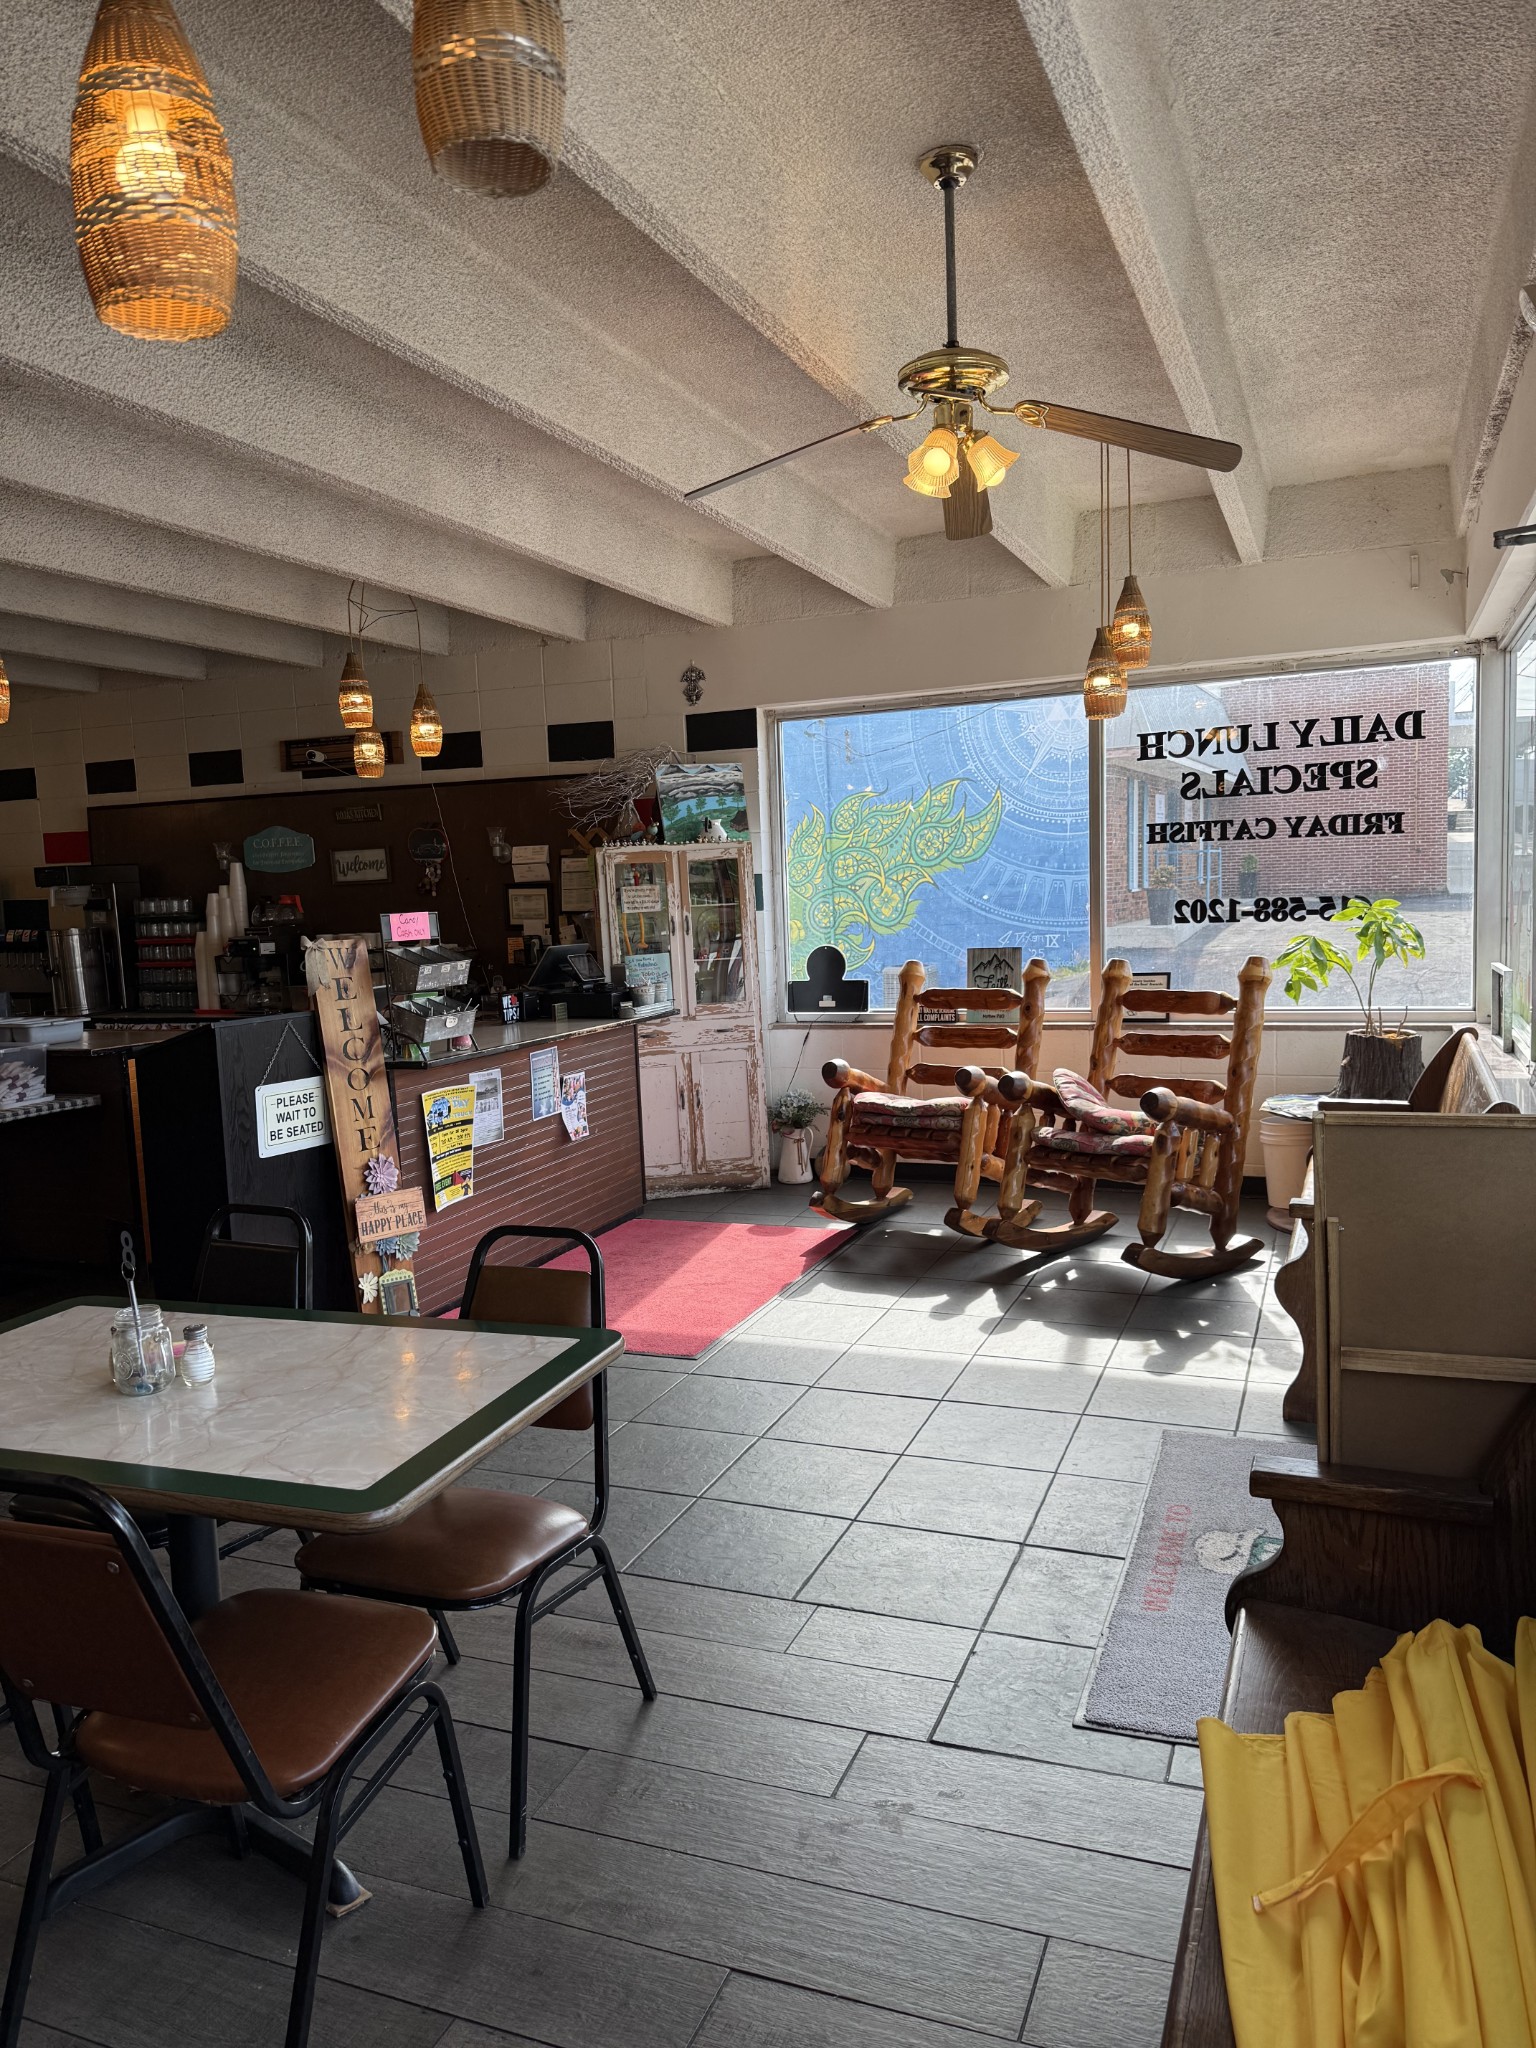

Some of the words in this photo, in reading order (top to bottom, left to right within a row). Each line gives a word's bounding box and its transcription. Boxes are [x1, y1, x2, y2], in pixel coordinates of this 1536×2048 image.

[336, 855, 385, 877] Welcome
[974, 974, 1012, 989] Faith
[502, 1007, 520, 1022] TIPS!
[327, 946, 381, 1152] WELCOME
[276, 1092, 315, 1109] PLEASE
[275, 1109, 301, 1124] WAIT
[303, 1106, 317, 1121] TO
[269, 1128, 284, 1142] BE
[286, 1120, 324, 1138] SEATED
[361, 1216, 392, 1237] HAPPY
[395, 1210, 424, 1229] PLACE
